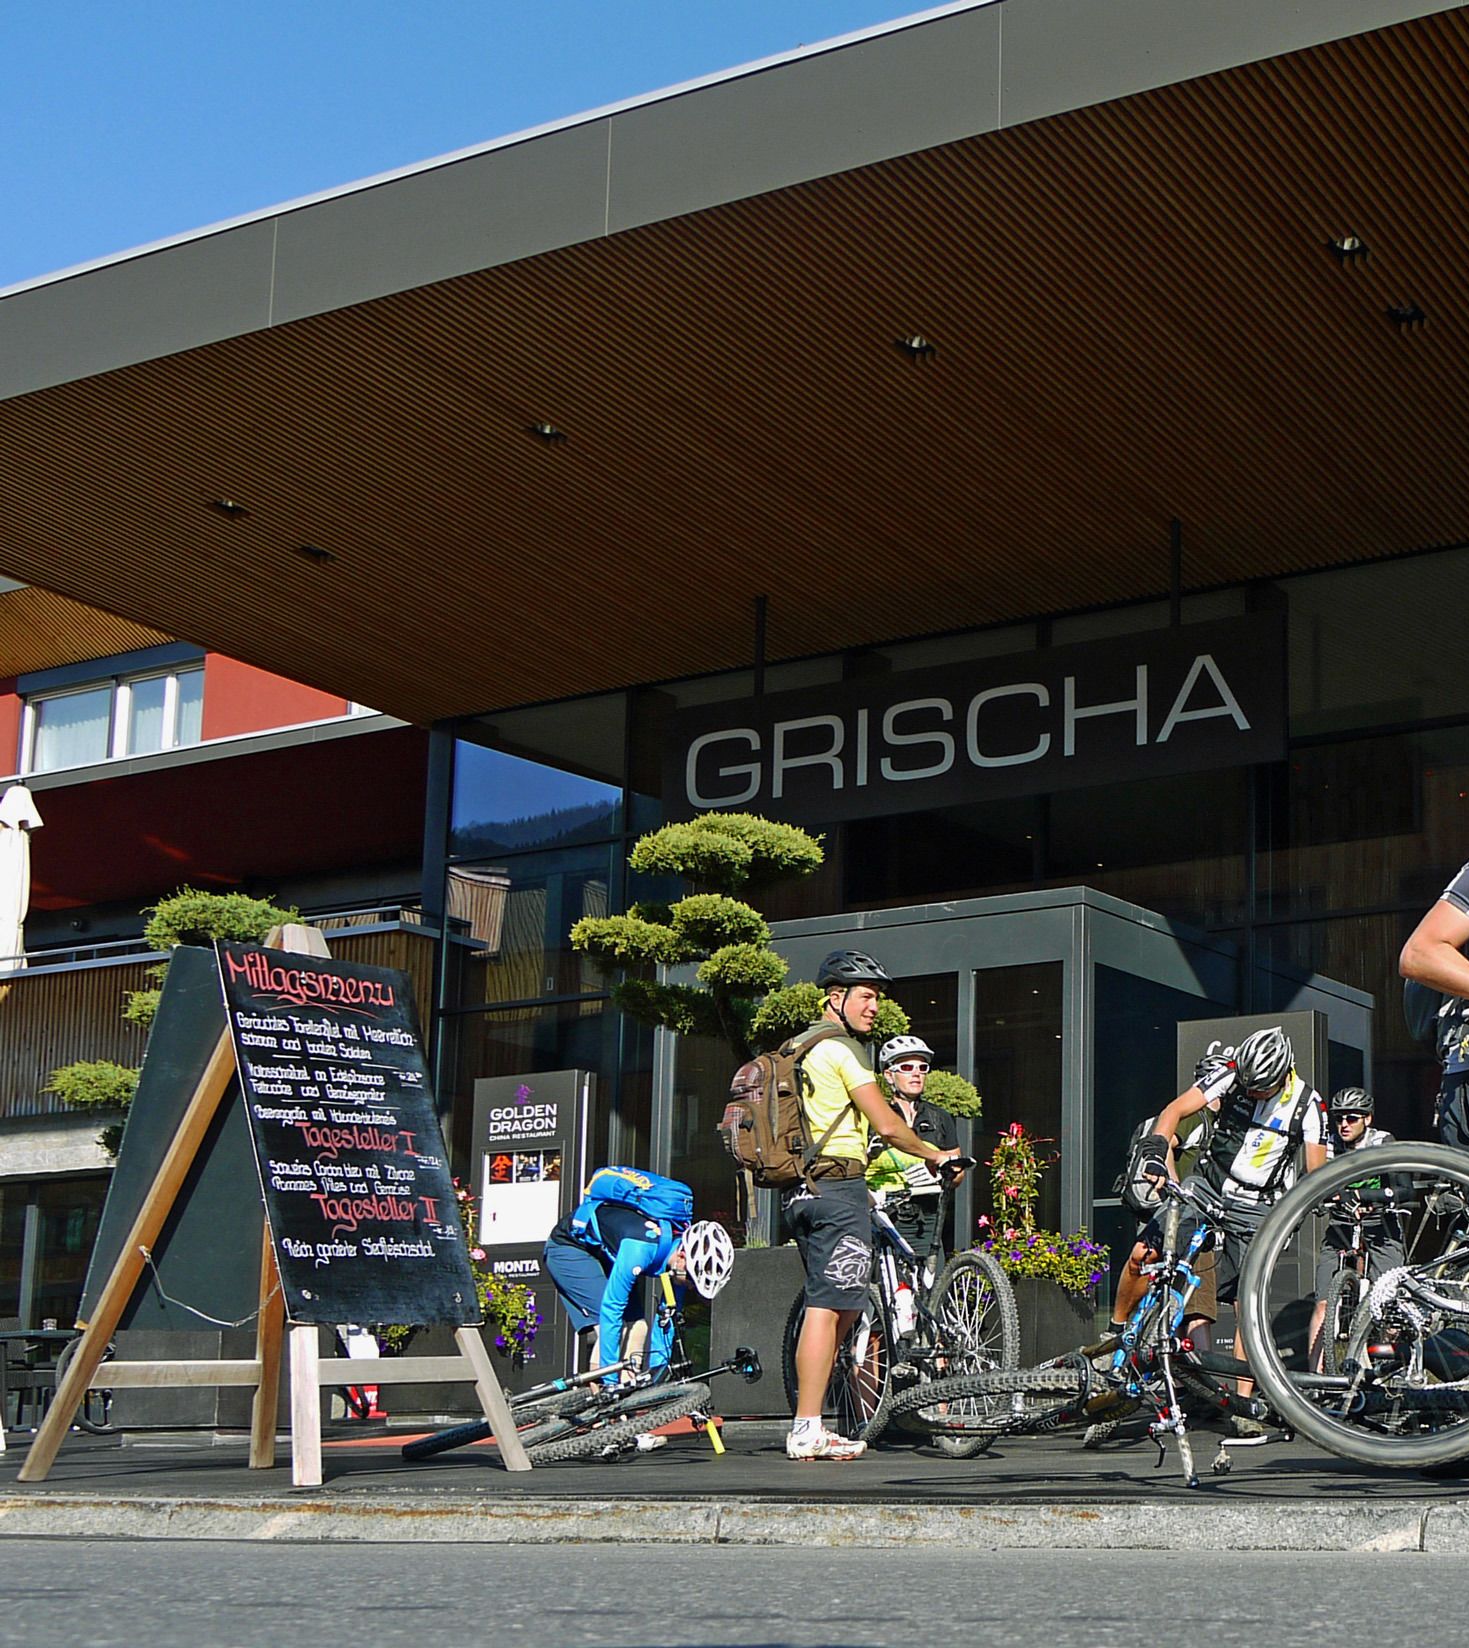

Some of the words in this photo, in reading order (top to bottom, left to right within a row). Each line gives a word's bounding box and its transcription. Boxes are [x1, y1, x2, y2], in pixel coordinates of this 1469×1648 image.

[685, 653, 1252, 808] GRISCHA
[344, 1024, 360, 1040] mit
[282, 1037, 301, 1051] und
[301, 1084, 320, 1097] und
[312, 1107, 326, 1121] mit
[490, 1104, 557, 1120] GOLDEN
[489, 1117, 556, 1133] DRAGON
[295, 1122, 398, 1159] Tagesteller
[512, 1130, 555, 1139] RESTAURANT
[366, 1164, 381, 1179] mit
[272, 1176, 317, 1192] Pommes
[350, 1181, 369, 1194] und
[310, 1194, 417, 1239] Tagesteller
[494, 1260, 540, 1273] MONTA
